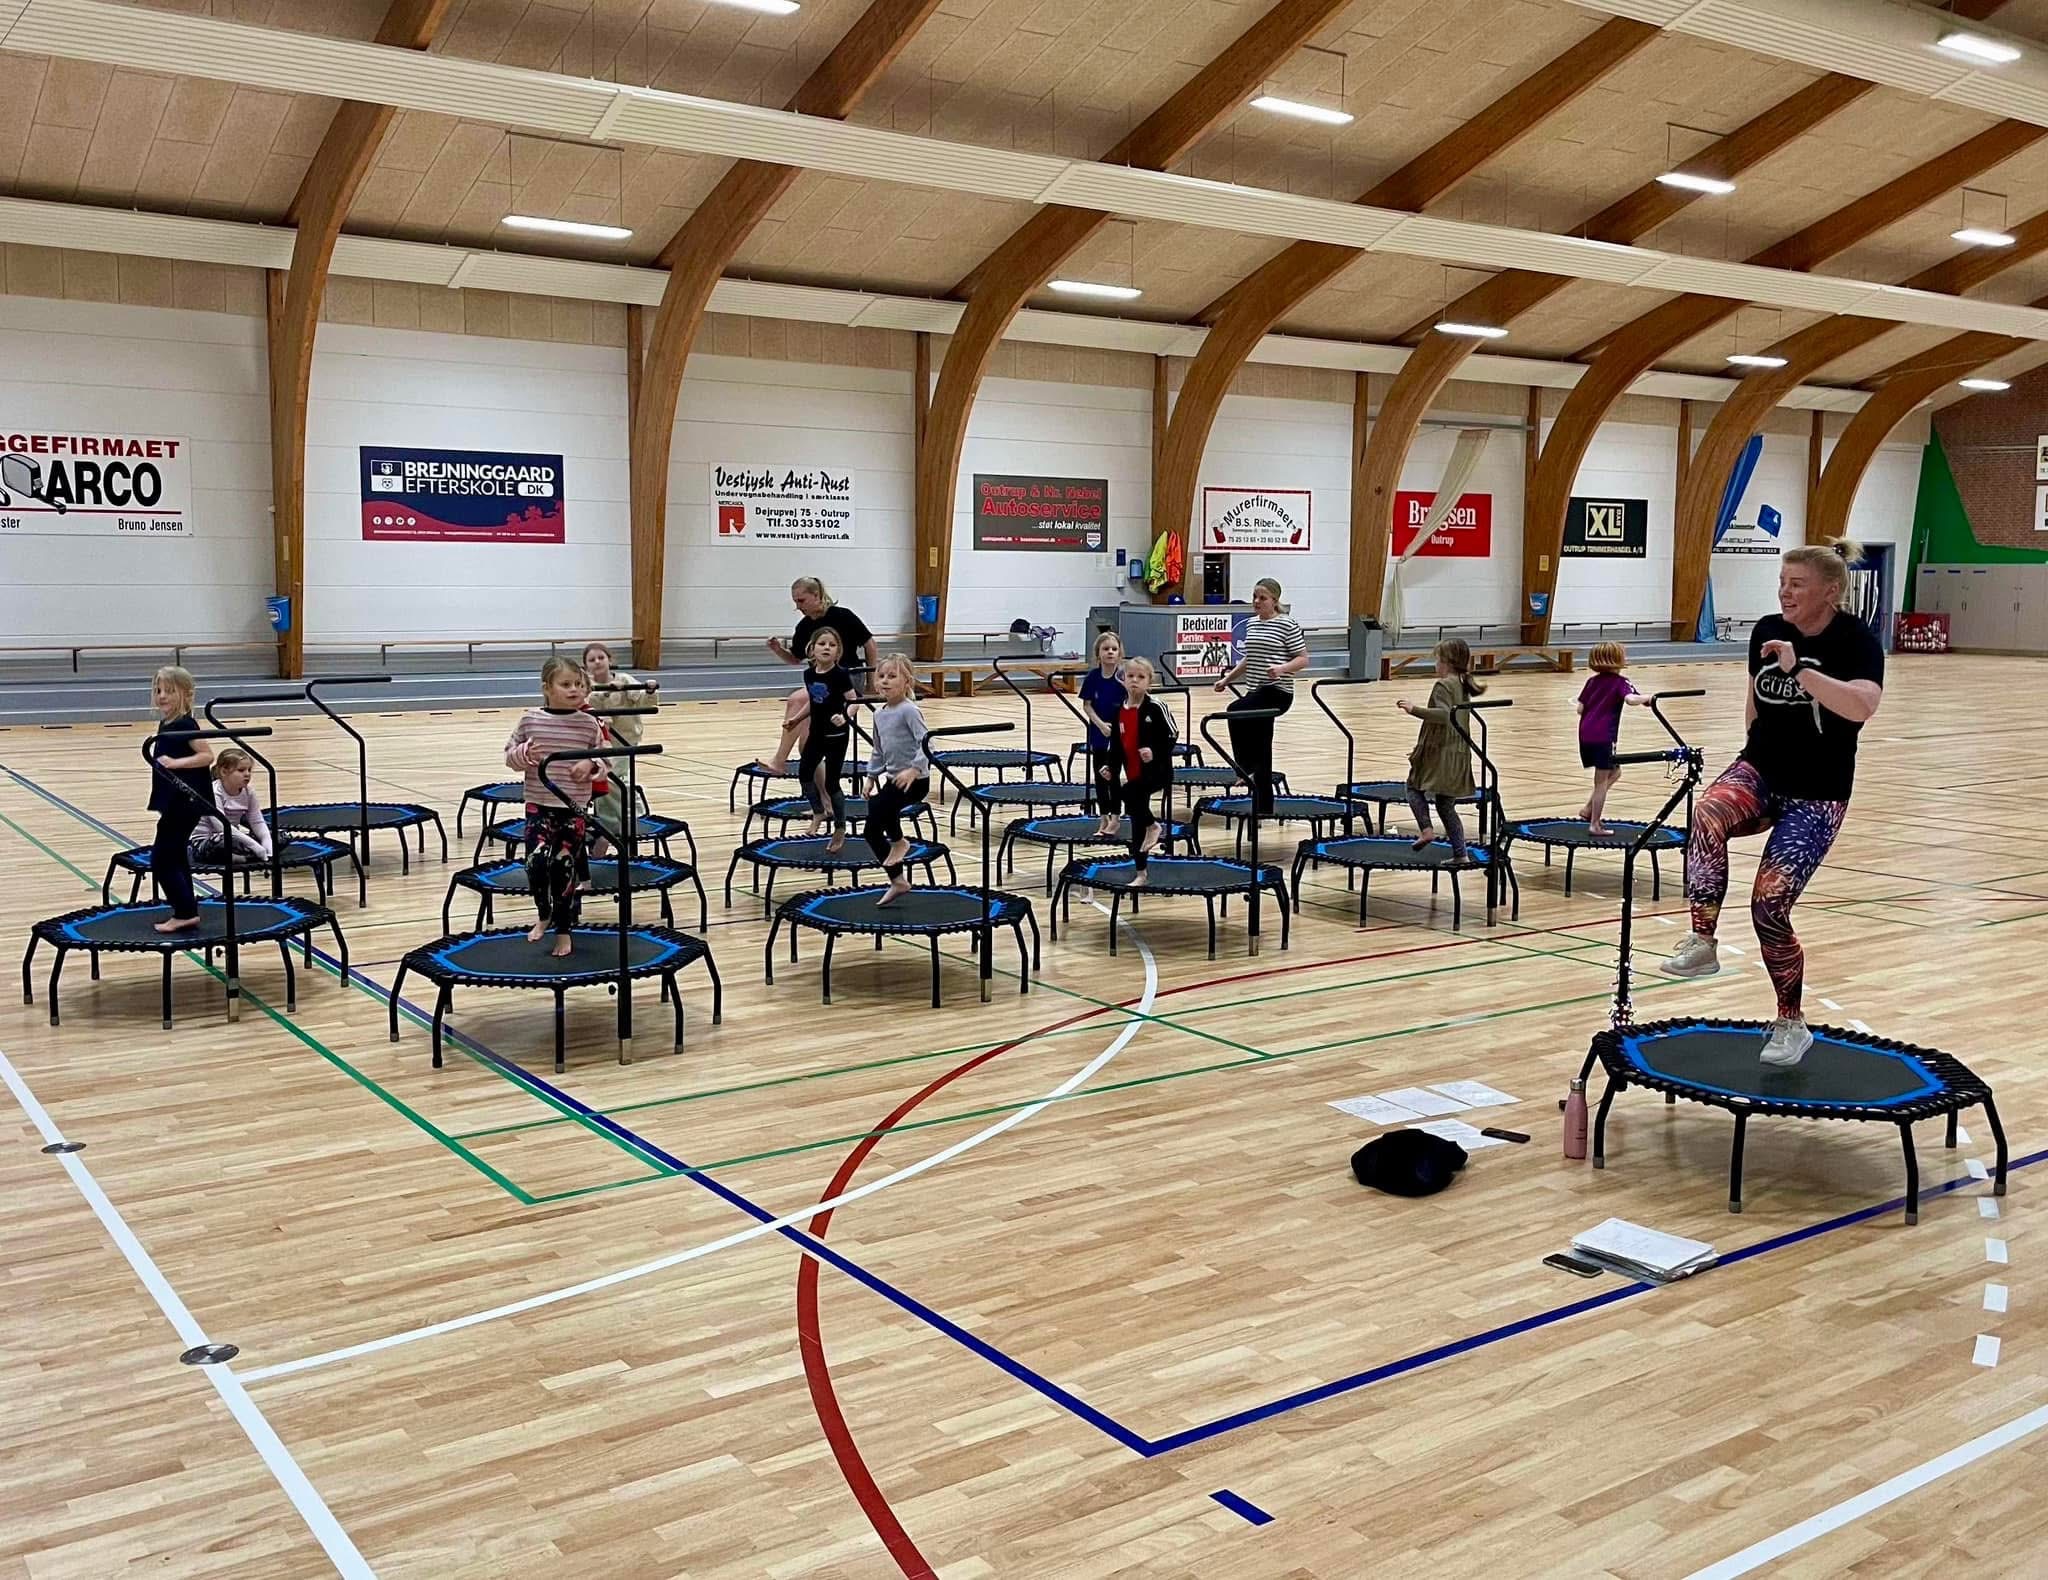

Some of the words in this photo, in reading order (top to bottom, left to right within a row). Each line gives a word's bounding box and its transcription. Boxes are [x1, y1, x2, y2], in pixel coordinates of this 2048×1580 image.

[404, 461, 555, 482] BREJNINGGAARD
[714, 466, 774, 491] Vestjysk
[780, 469, 850, 493] Anti-Rust
[46, 460, 162, 507] ARCO
[406, 478, 515, 496] EFTERSKOLE
[527, 484, 545, 495] DK
[981, 482, 1027, 500] Outrup
[755, 506, 797, 518] Dejrupvej
[800, 508, 812, 517] 75
[820, 509, 851, 519] Outrup
[982, 497, 1102, 519] Autoservice
[1223, 495, 1294, 528] Murerfirmaet
[1408, 500, 1477, 531] Brsen
[118, 518, 146, 531] Bruno
[150, 519, 183, 531] Jensen
[1054, 520, 1075, 530] lokal
[1588, 507, 1621, 537] XL
